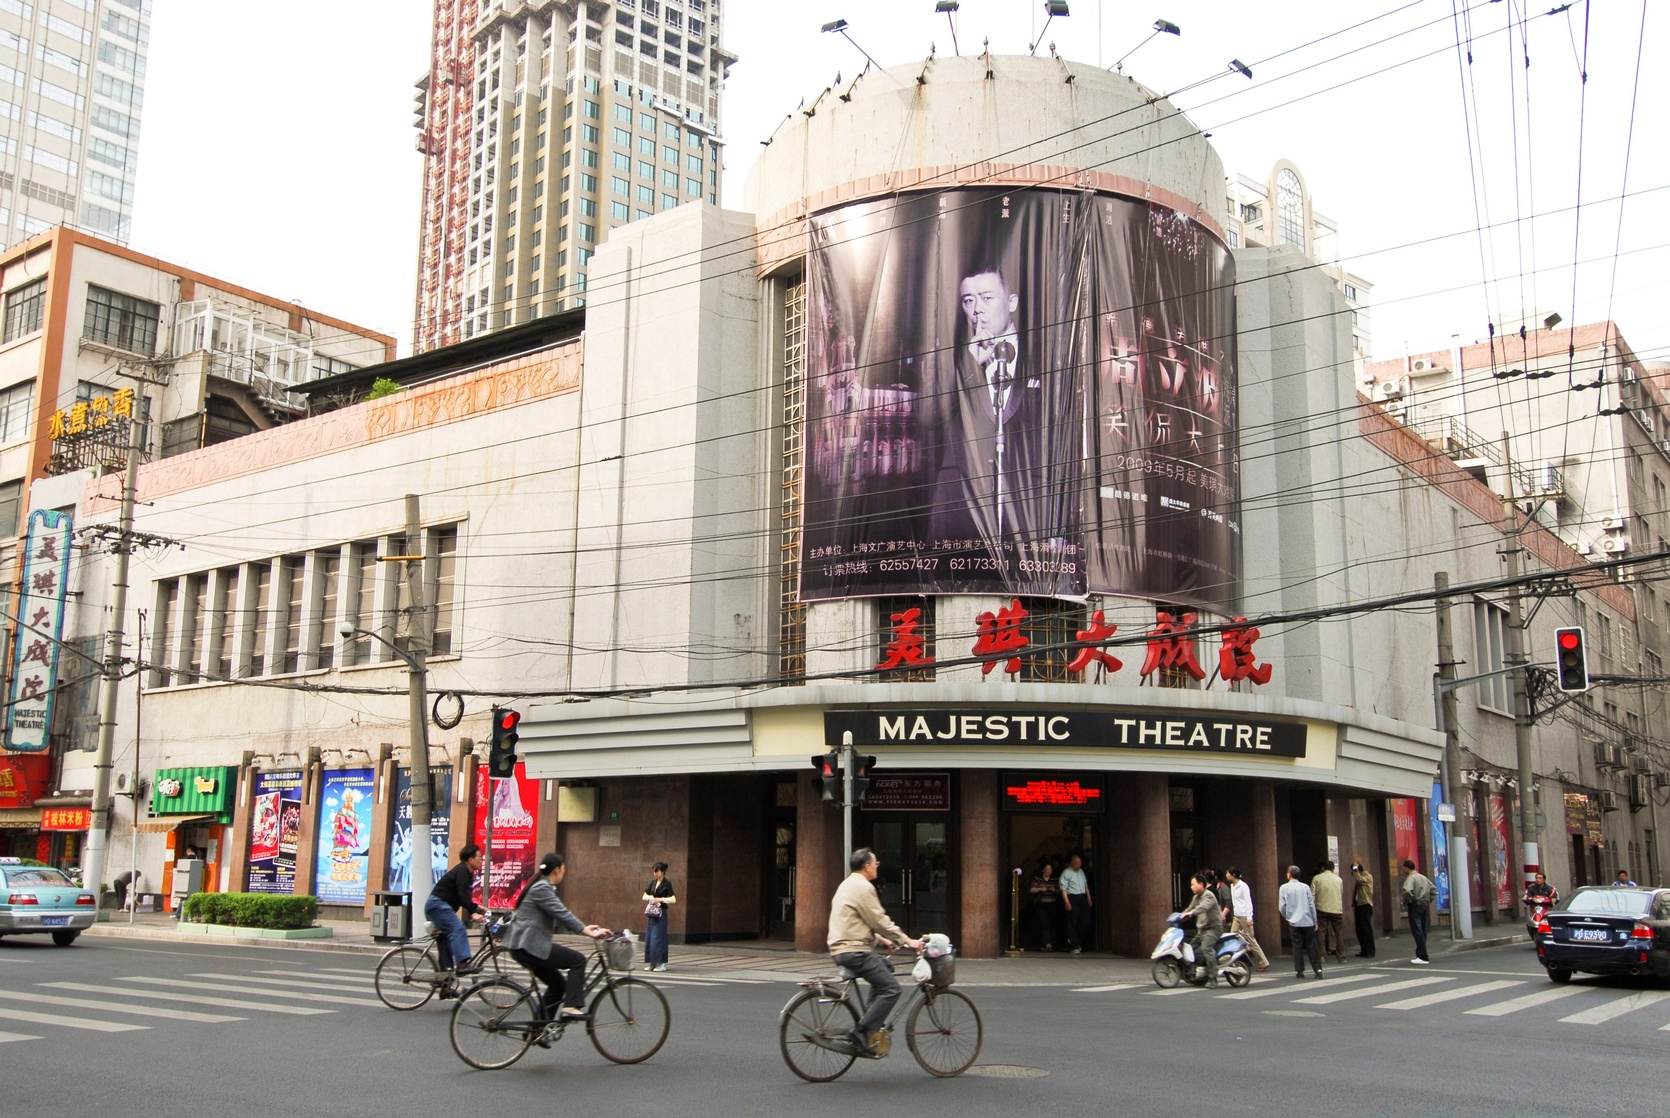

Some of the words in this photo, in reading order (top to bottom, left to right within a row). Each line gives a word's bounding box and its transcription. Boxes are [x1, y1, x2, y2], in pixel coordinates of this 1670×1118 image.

[1117, 455, 1197, 486] 2009年5月起
[852, 540, 926, 554] 上海文广演艺中心
[880, 558, 939, 571] 62557427
[949, 558, 1010, 570] 62173311
[15, 708, 47, 719] MAJESTIC
[15, 719, 46, 730] THEATRE
[878, 714, 1071, 741] MAJESTIC
[1113, 718, 1273, 750] THEATRE
[51, 810, 83, 826] 桂林米粉
